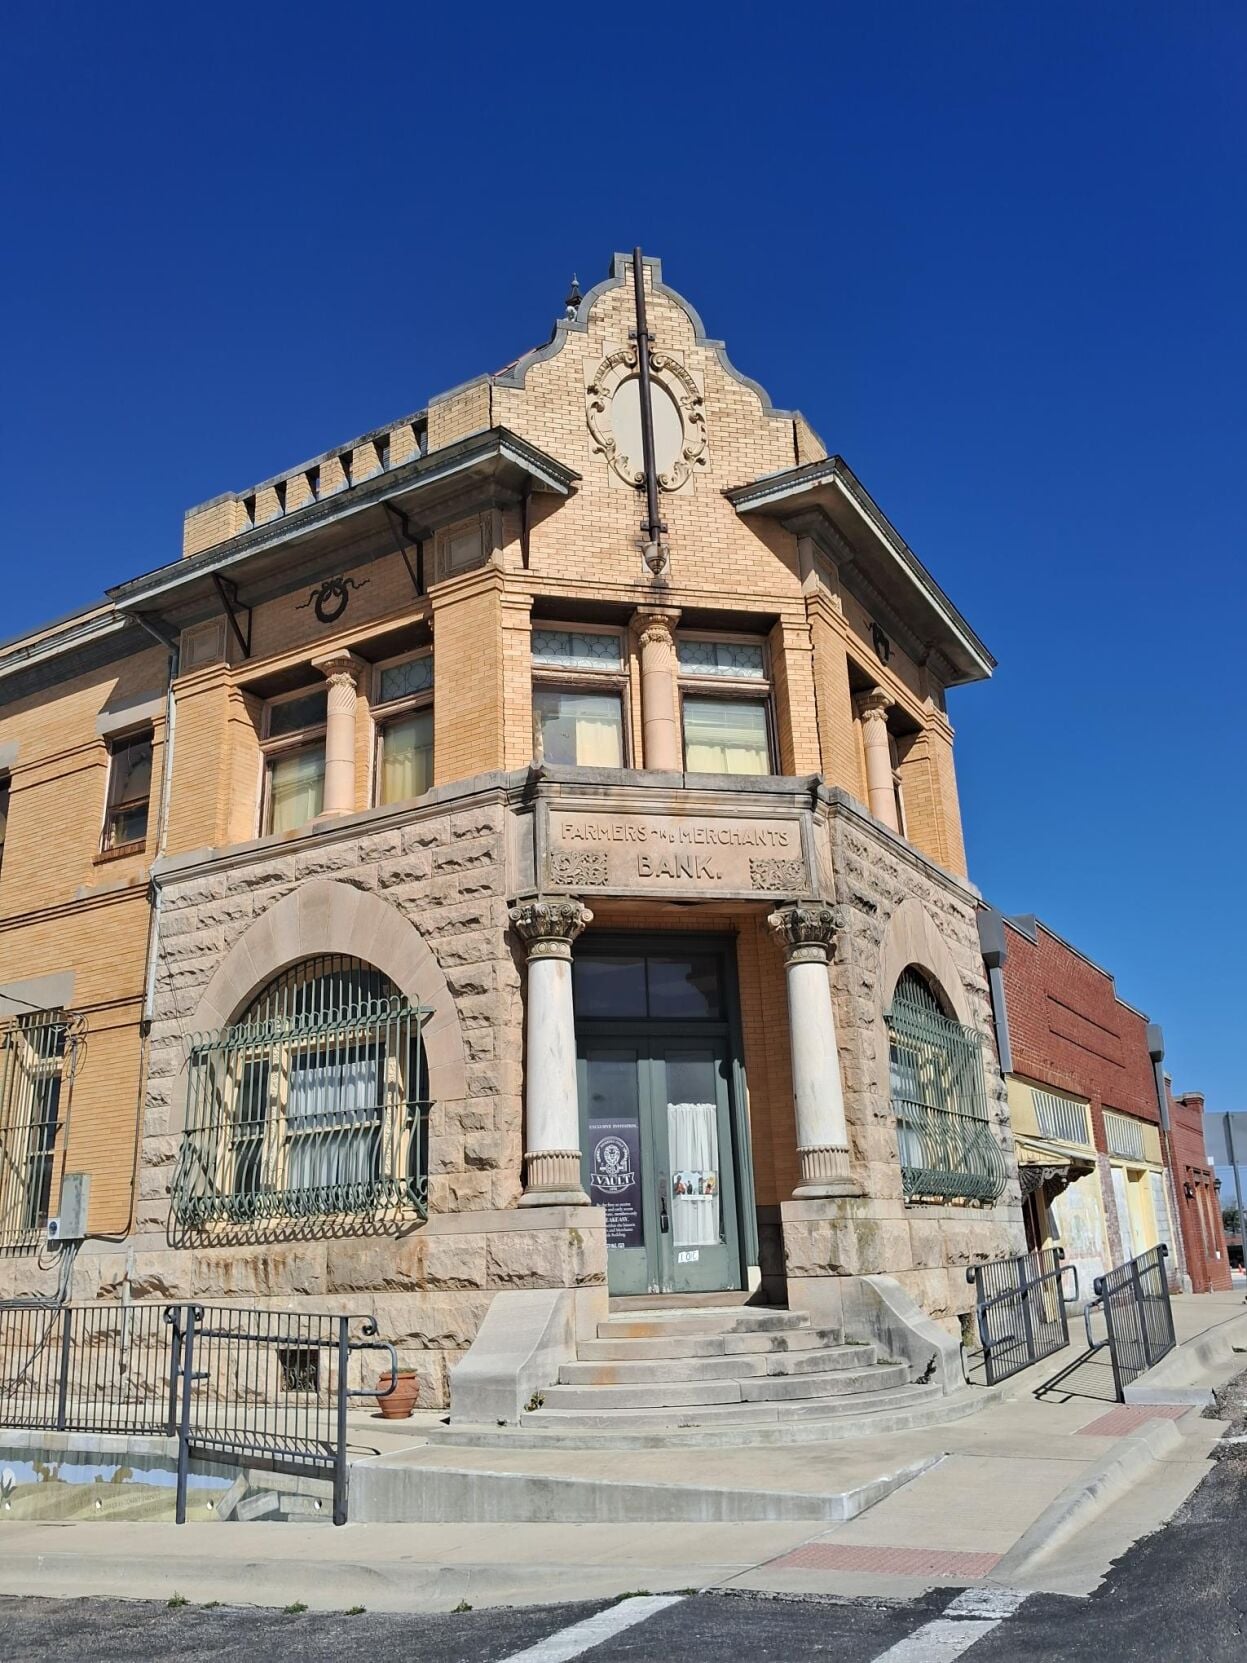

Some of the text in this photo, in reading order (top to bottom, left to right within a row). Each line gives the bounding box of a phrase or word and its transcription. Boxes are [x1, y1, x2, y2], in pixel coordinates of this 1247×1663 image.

[561, 823, 648, 842] FARMERS
[679, 827, 790, 847] MERCHANTS
[596, 1174, 630, 1186] VAULT
